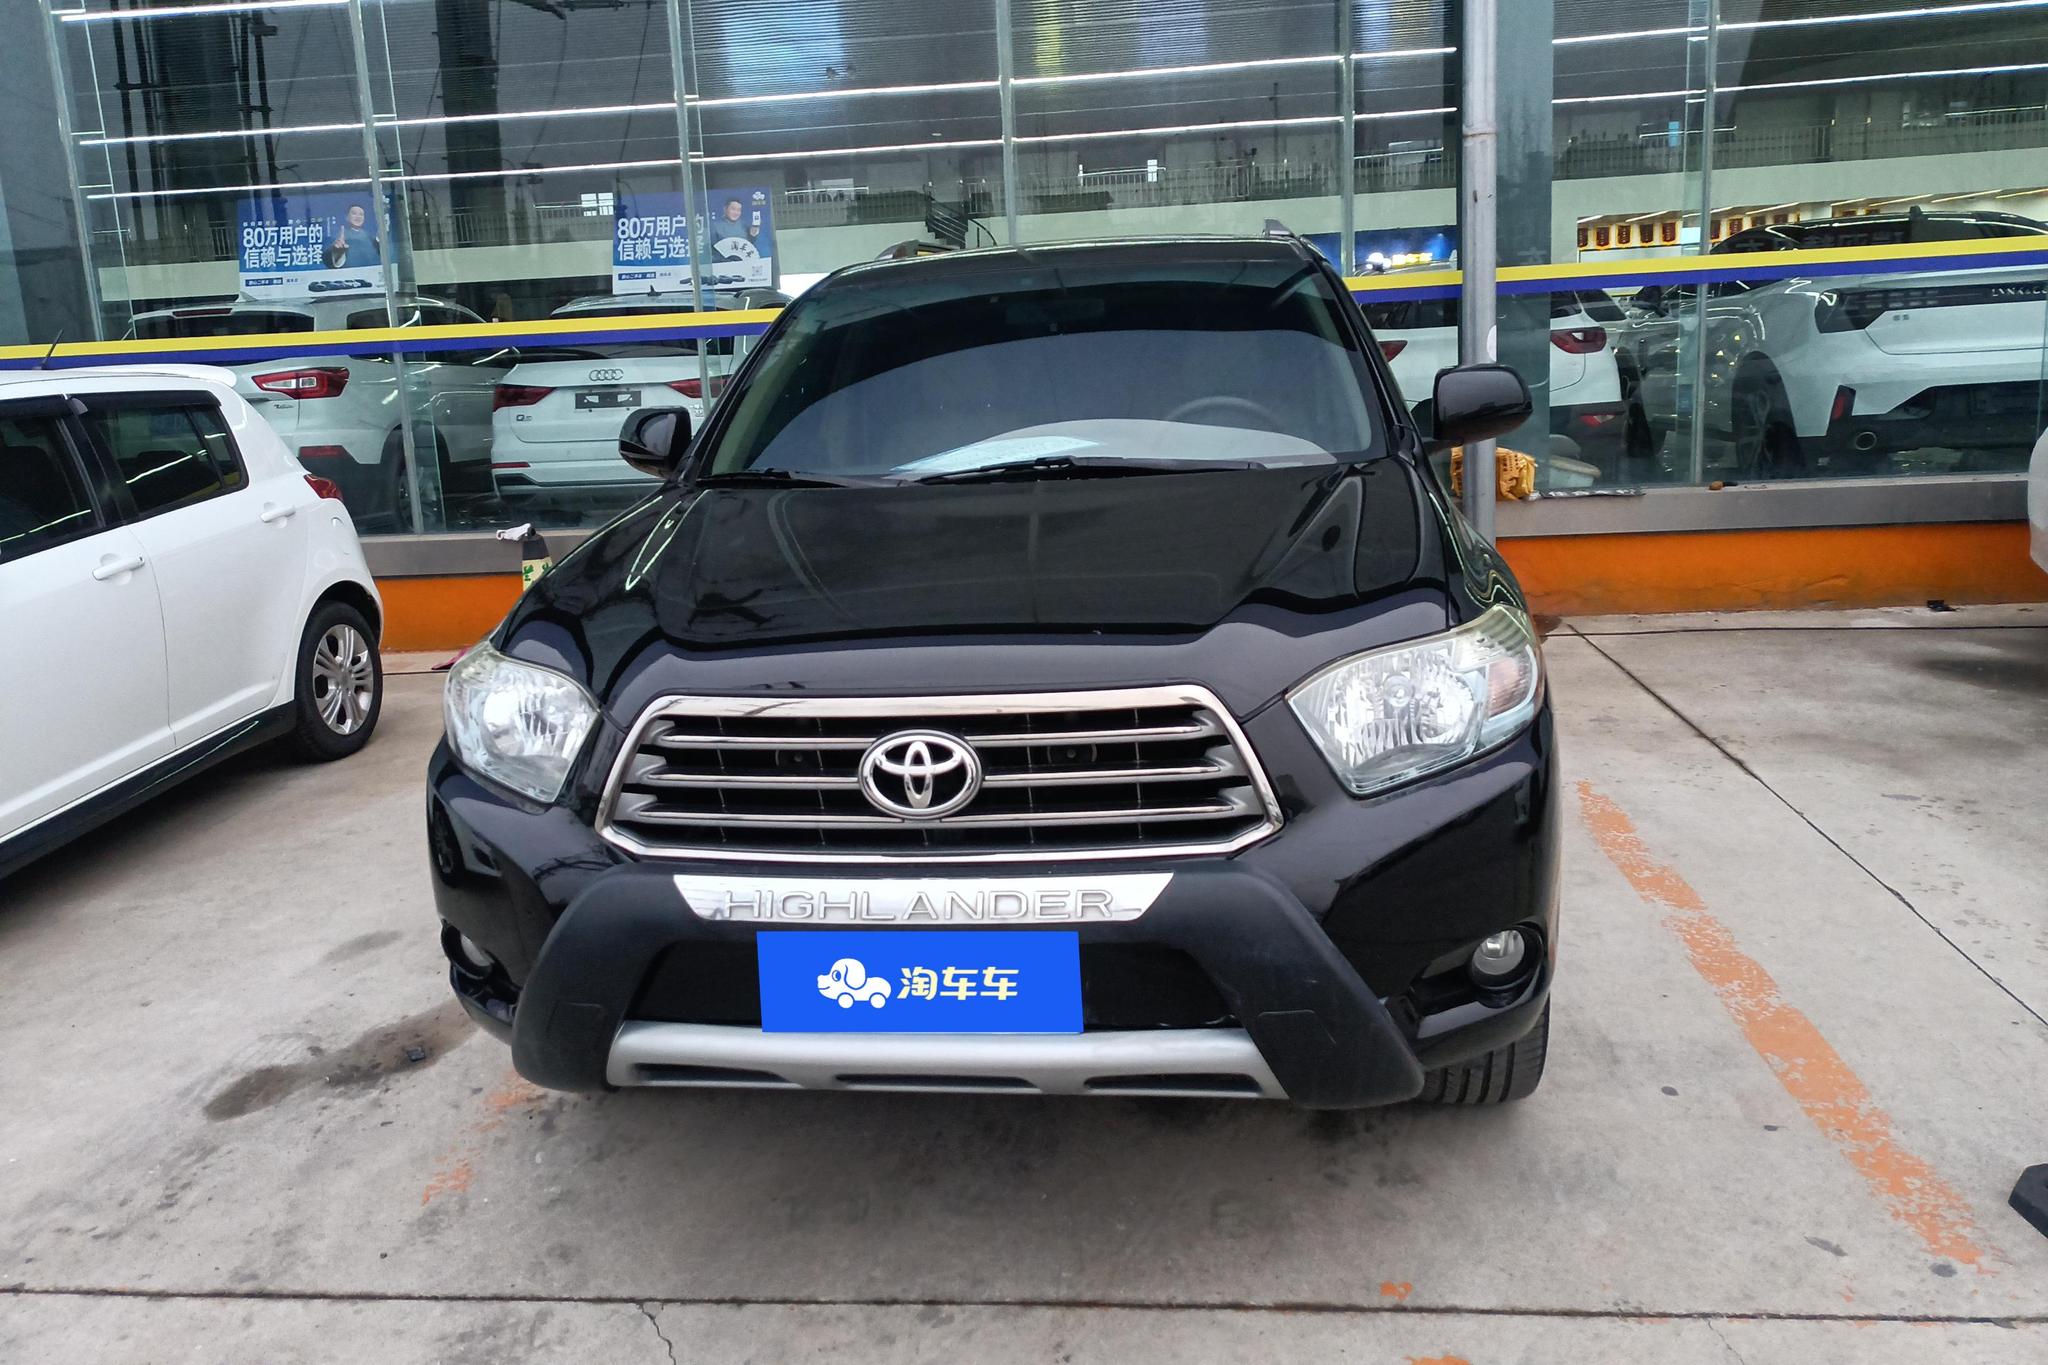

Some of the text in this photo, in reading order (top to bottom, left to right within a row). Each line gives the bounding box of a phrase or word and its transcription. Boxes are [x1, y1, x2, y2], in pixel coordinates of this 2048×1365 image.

[242, 224, 323, 248] 80万用户的
[243, 244, 324, 269] 信赖与选择
[724, 889, 1114, 921] HIGHLANDER
